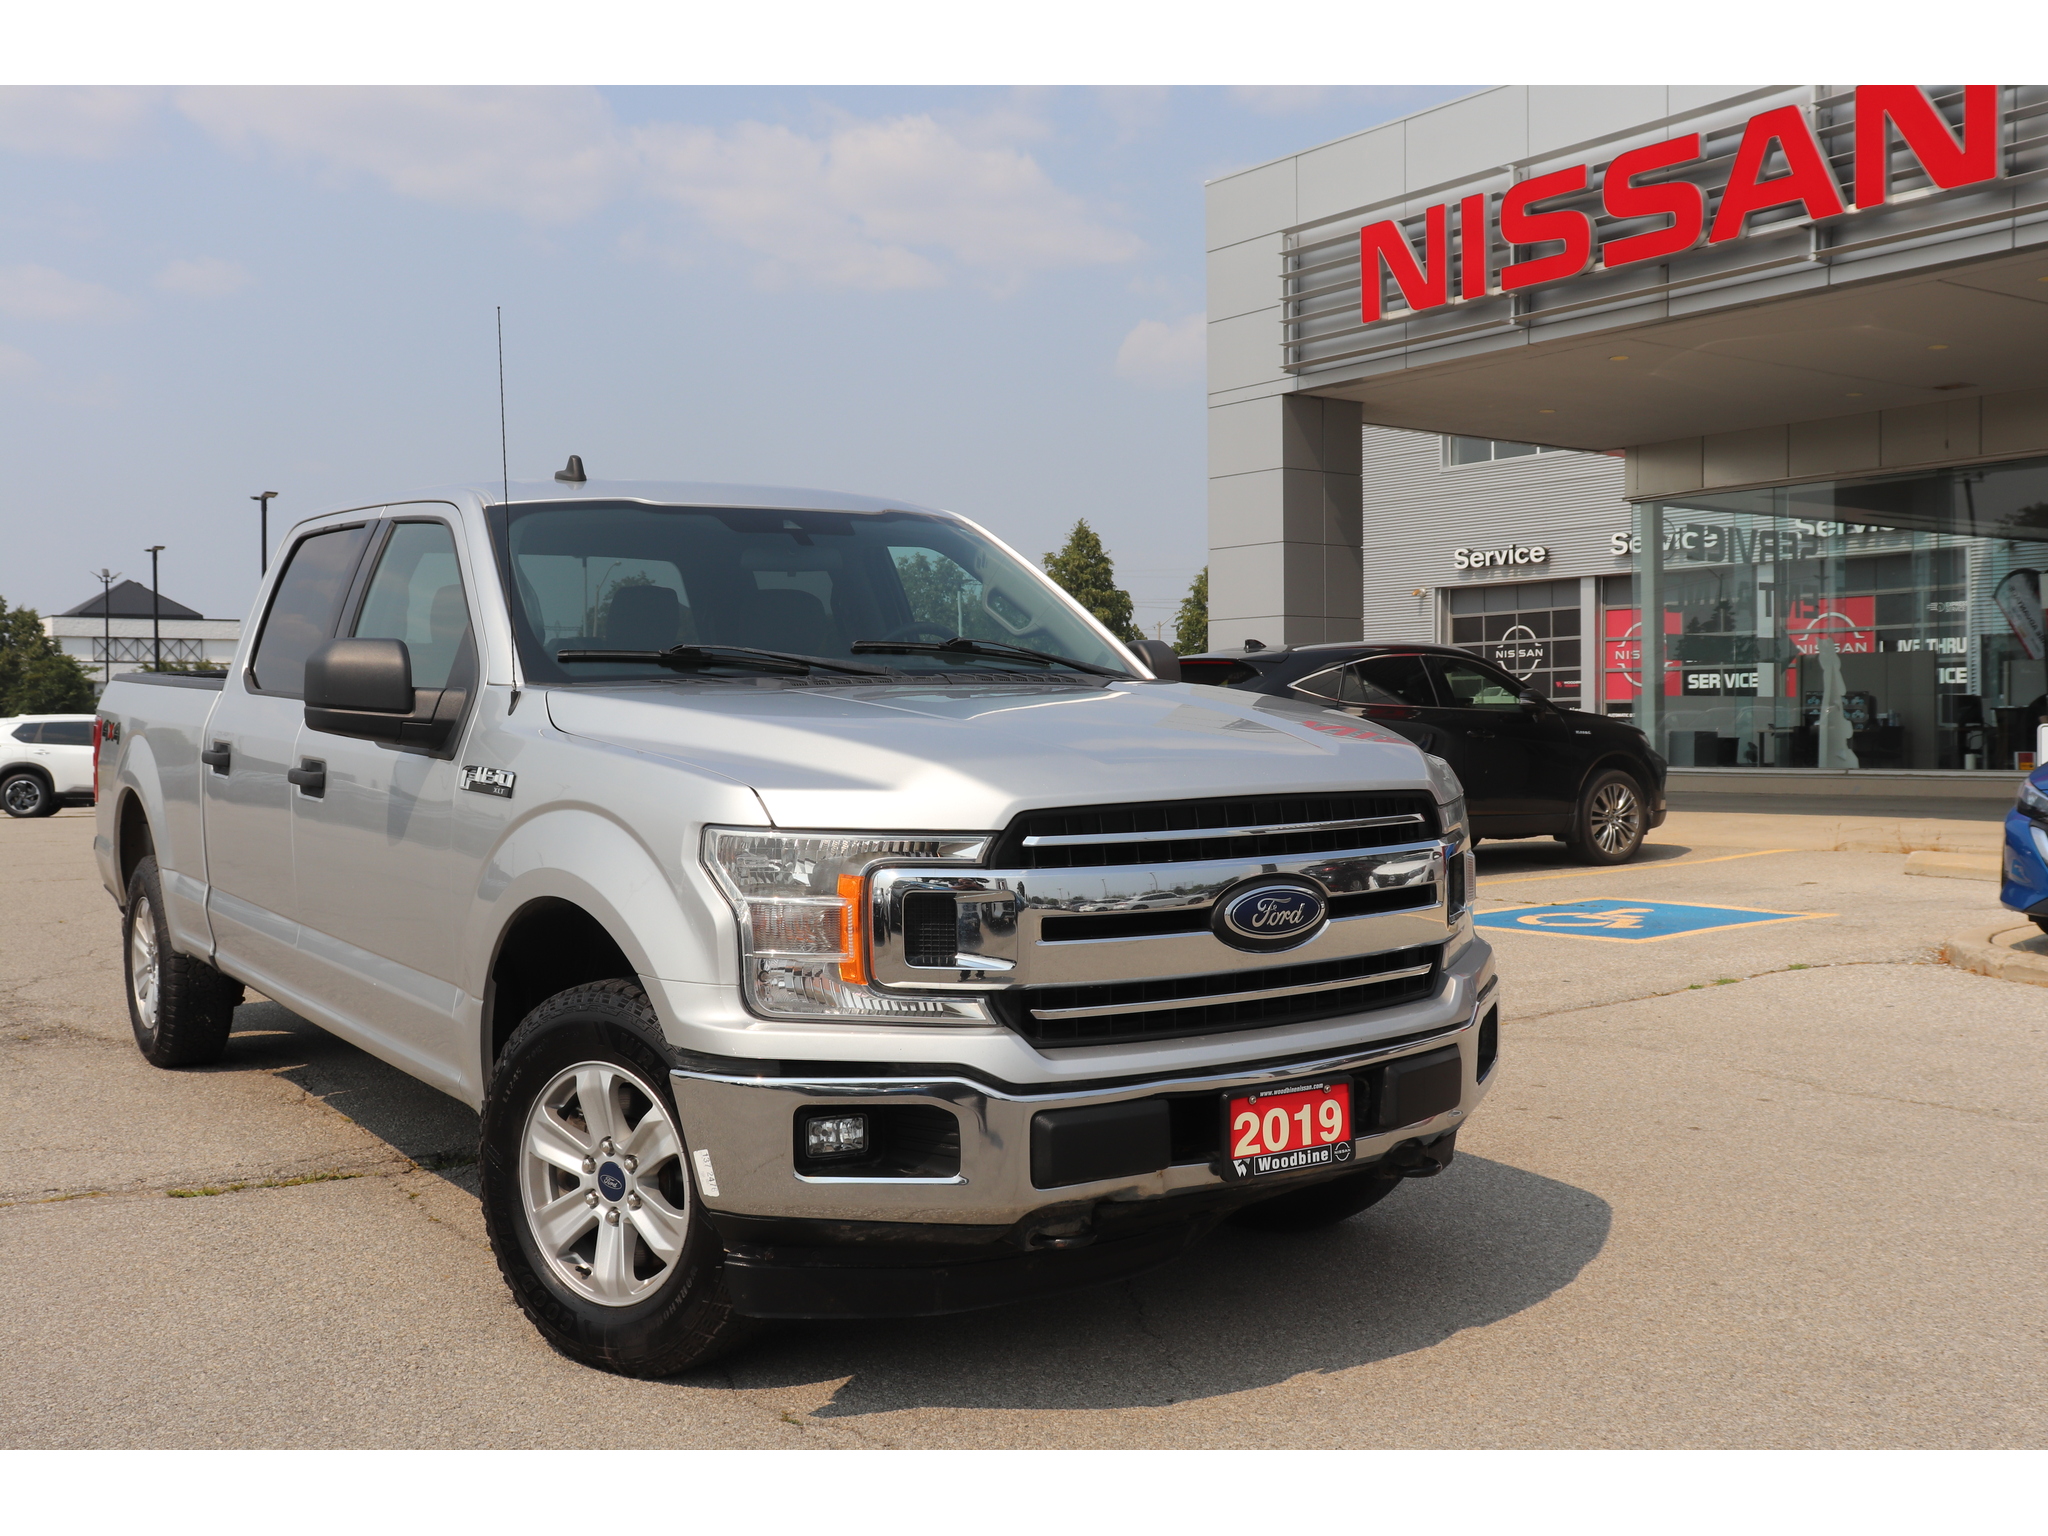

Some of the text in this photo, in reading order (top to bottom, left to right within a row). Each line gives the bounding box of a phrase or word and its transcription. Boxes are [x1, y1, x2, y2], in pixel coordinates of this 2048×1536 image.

[1361, 85, 1999, 324] NISSAN
[1454, 544, 1547, 570] Service
[1495, 648, 1543, 659] NISSAN
[1615, 650, 1641, 660] NIS
[1688, 673, 1759, 689] SERVICE
[493, 787, 506, 795] XLT
[1252, 897, 1306, 927] Ford
[1259, 1083, 1324, 1097] www.woodbinenissan.com
[1233, 1099, 1343, 1157] 2019
[1258, 1149, 1329, 1172] Woodbine
